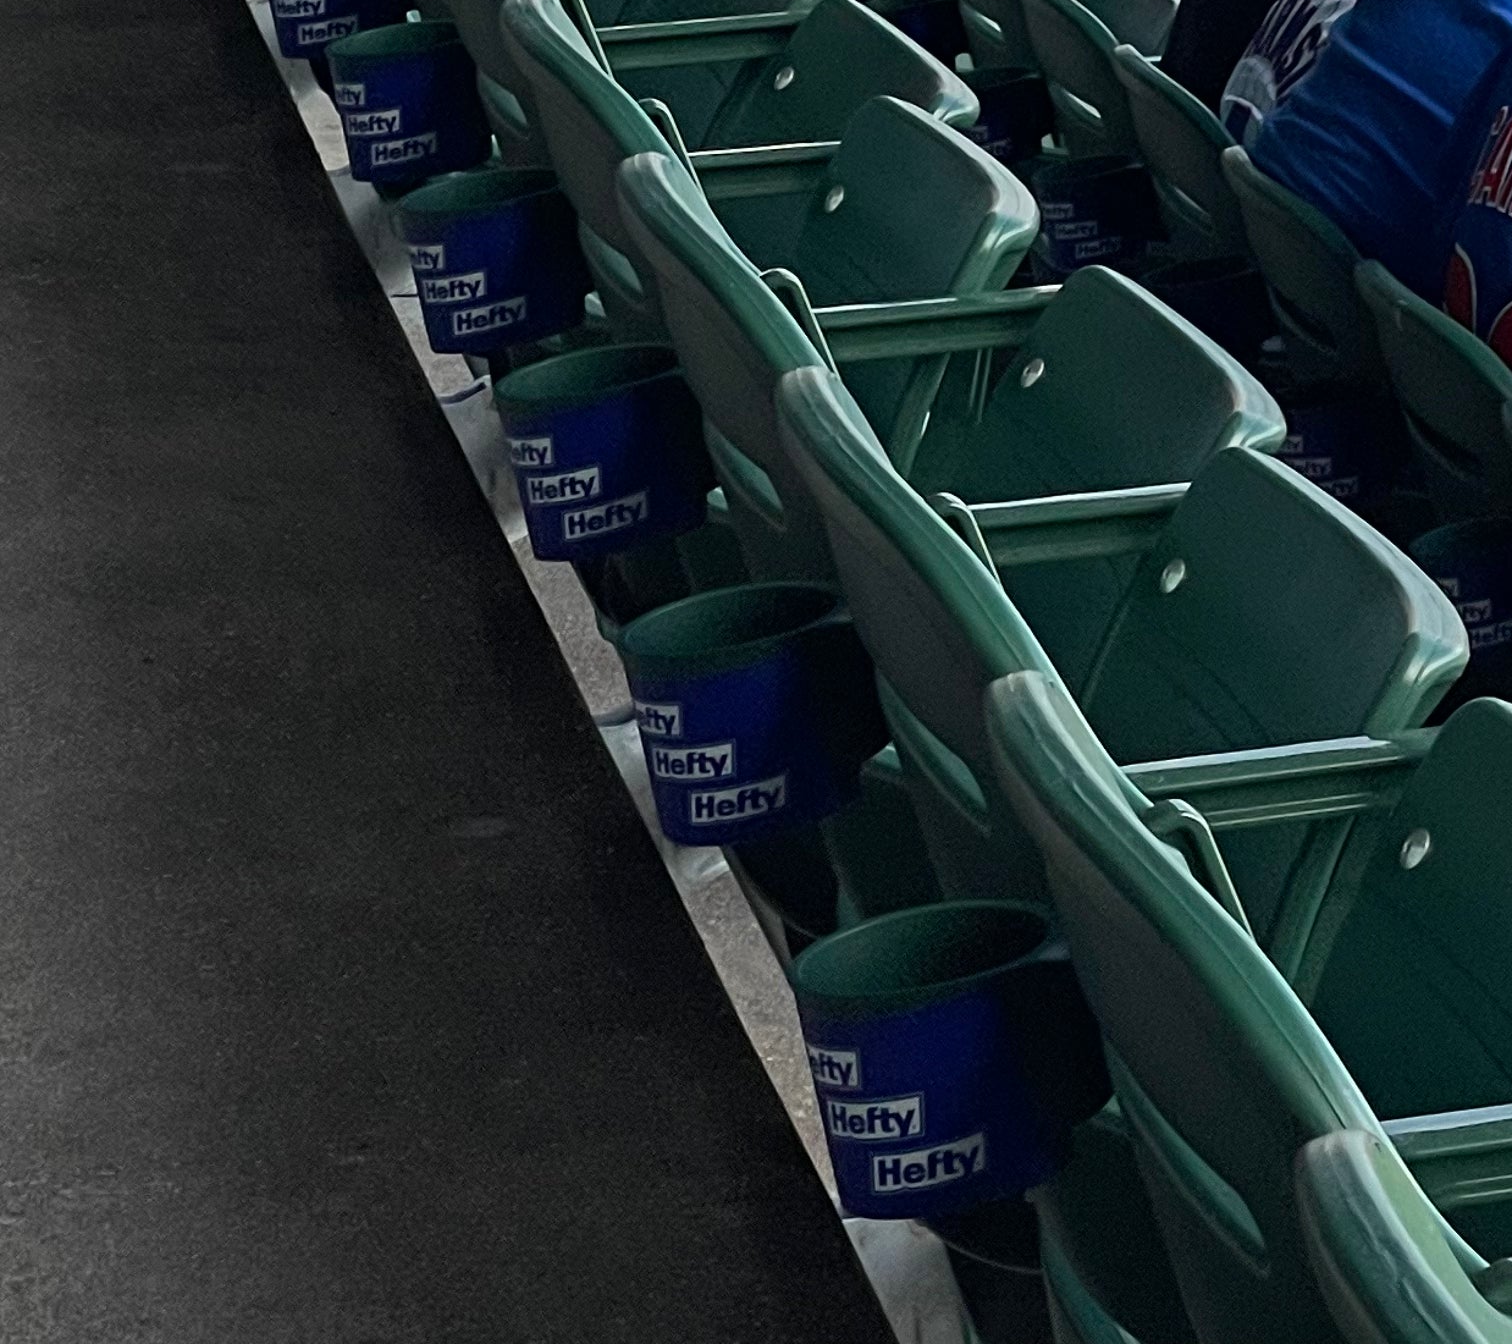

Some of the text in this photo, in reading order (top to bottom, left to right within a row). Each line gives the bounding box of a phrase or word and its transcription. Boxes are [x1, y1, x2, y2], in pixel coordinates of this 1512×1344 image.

[350, 115, 398, 133] Hefty
[374, 136, 436, 162] Hefty
[425, 278, 483, 303] Hefty
[457, 302, 525, 332] Hefty
[530, 475, 596, 501] Hefty
[568, 501, 643, 537] Hefty
[655, 750, 729, 777] Hefty
[694, 786, 782, 820] Hefty
[831, 1104, 915, 1138] Hefty
[877, 1145, 982, 1187] Hefty
